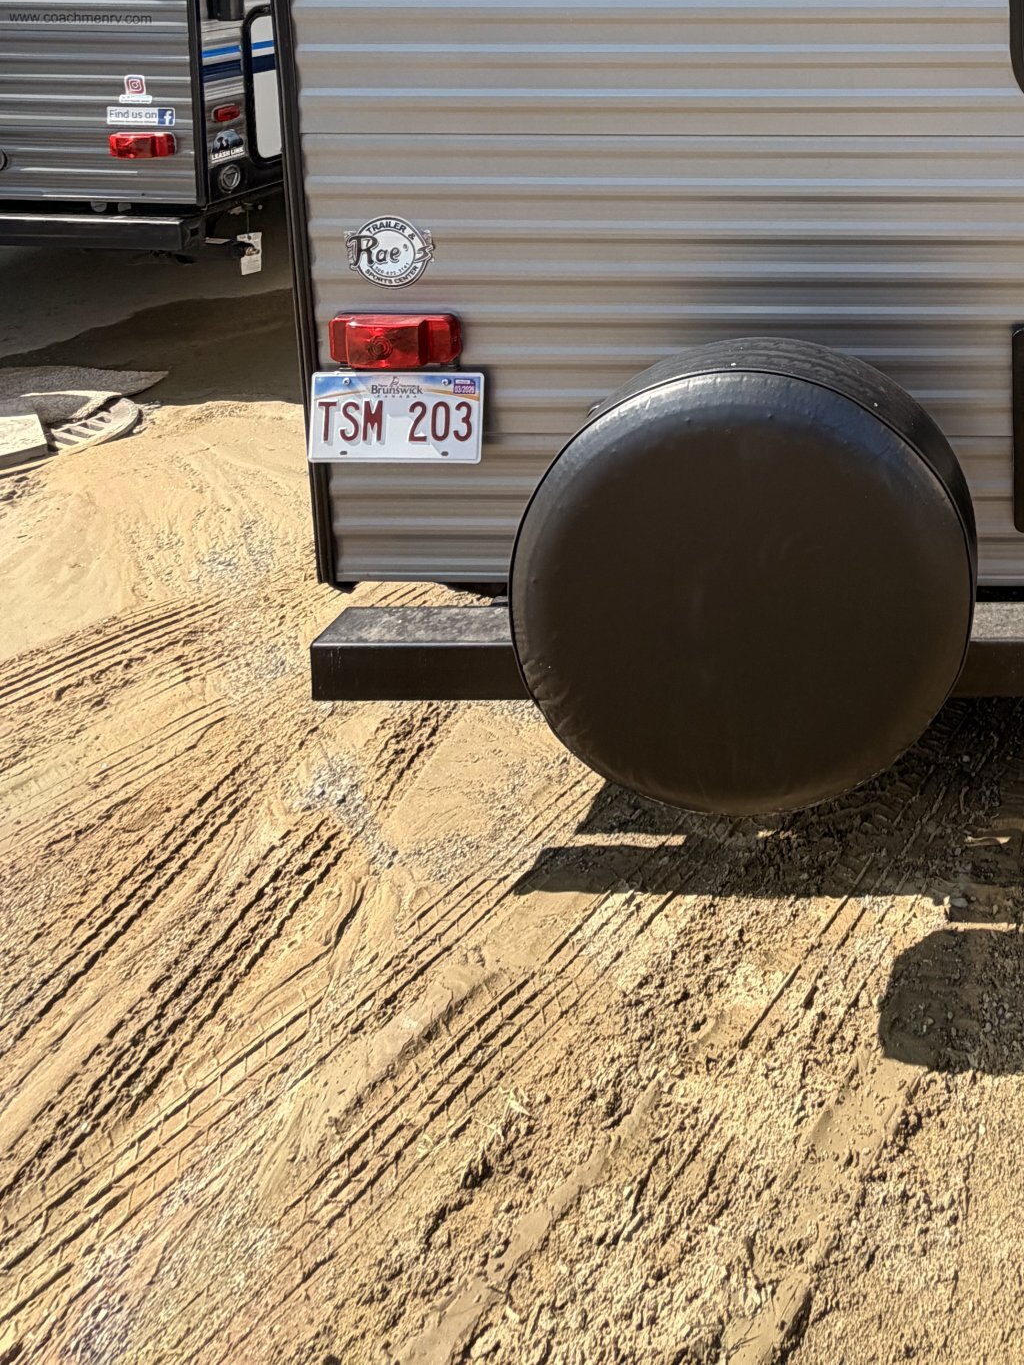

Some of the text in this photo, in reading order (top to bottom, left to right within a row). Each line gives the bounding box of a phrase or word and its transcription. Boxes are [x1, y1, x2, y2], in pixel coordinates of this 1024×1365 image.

[9, 11, 152, 25] www.coachmenrv.com
[109, 109, 129, 119] Find
[366, 221, 407, 234] TRAILER
[365, 265, 419, 284] SPORTS CENTER
[371, 385, 424, 394] Brunswick
[318, 401, 473, 442] TSM 203
